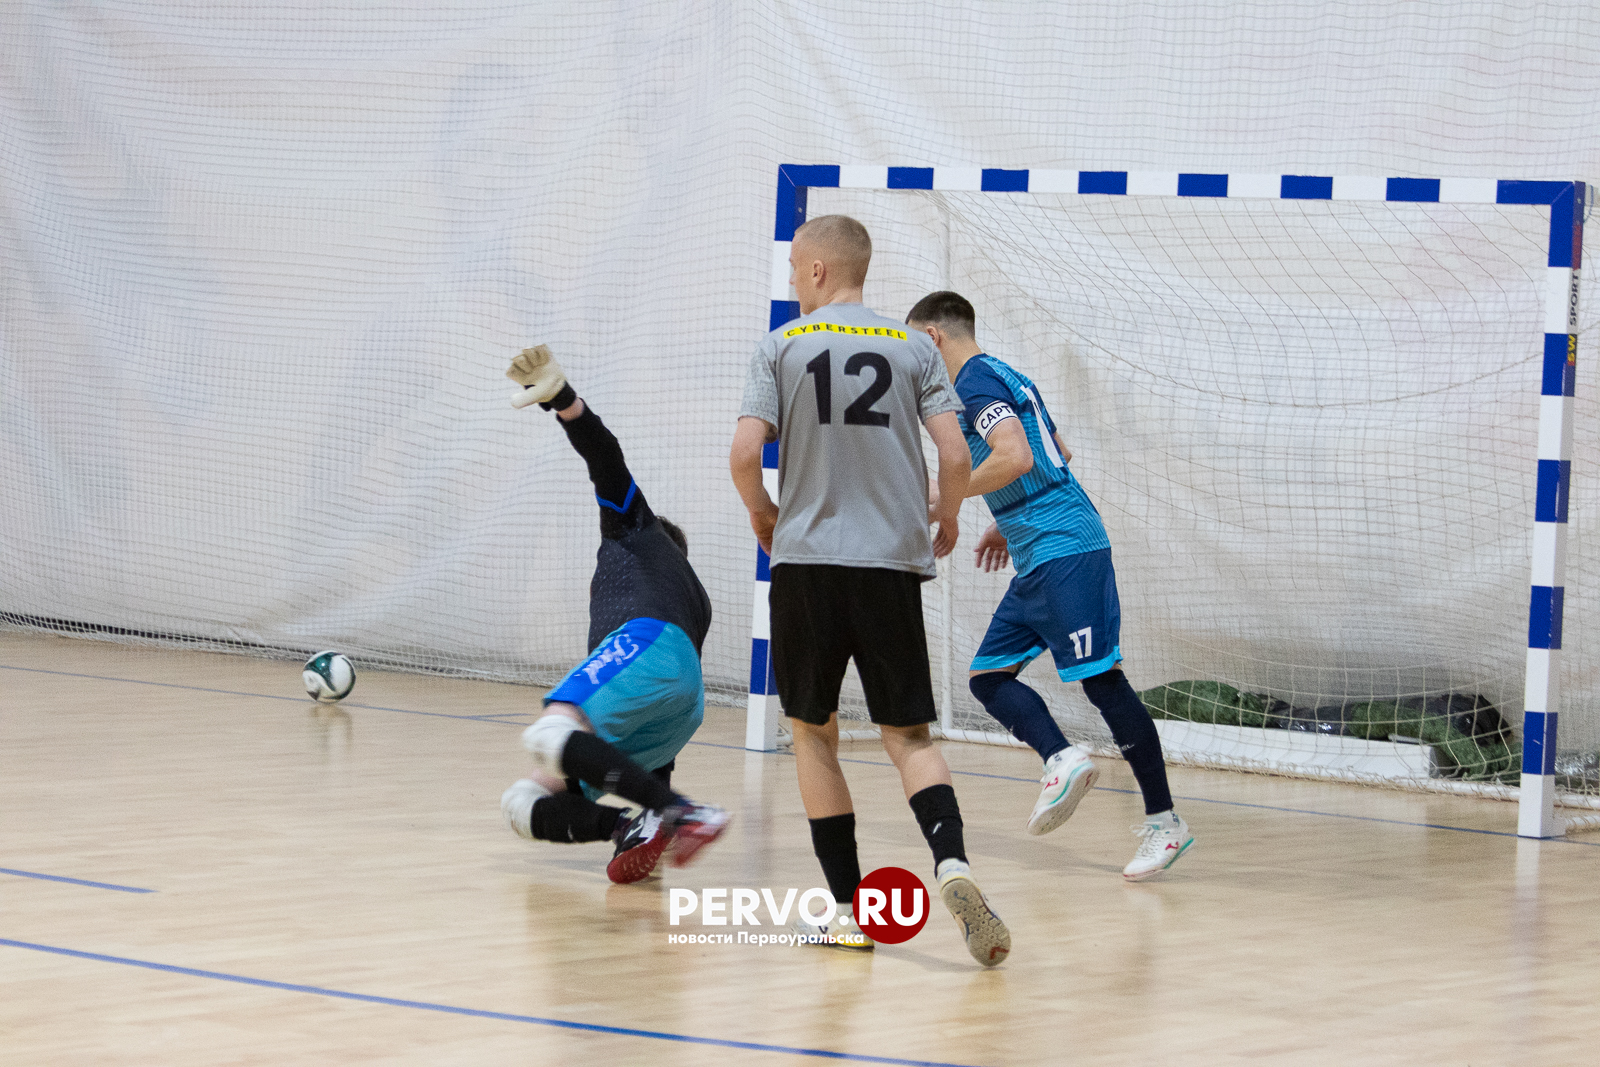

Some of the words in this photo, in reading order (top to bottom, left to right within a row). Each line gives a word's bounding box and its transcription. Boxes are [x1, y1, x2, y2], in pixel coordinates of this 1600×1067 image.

[1569, 274, 1579, 326] SPORT
[786, 323, 904, 340] CYBERSTEEL
[806, 348, 893, 429] 12
[1068, 626, 1092, 660] 17
